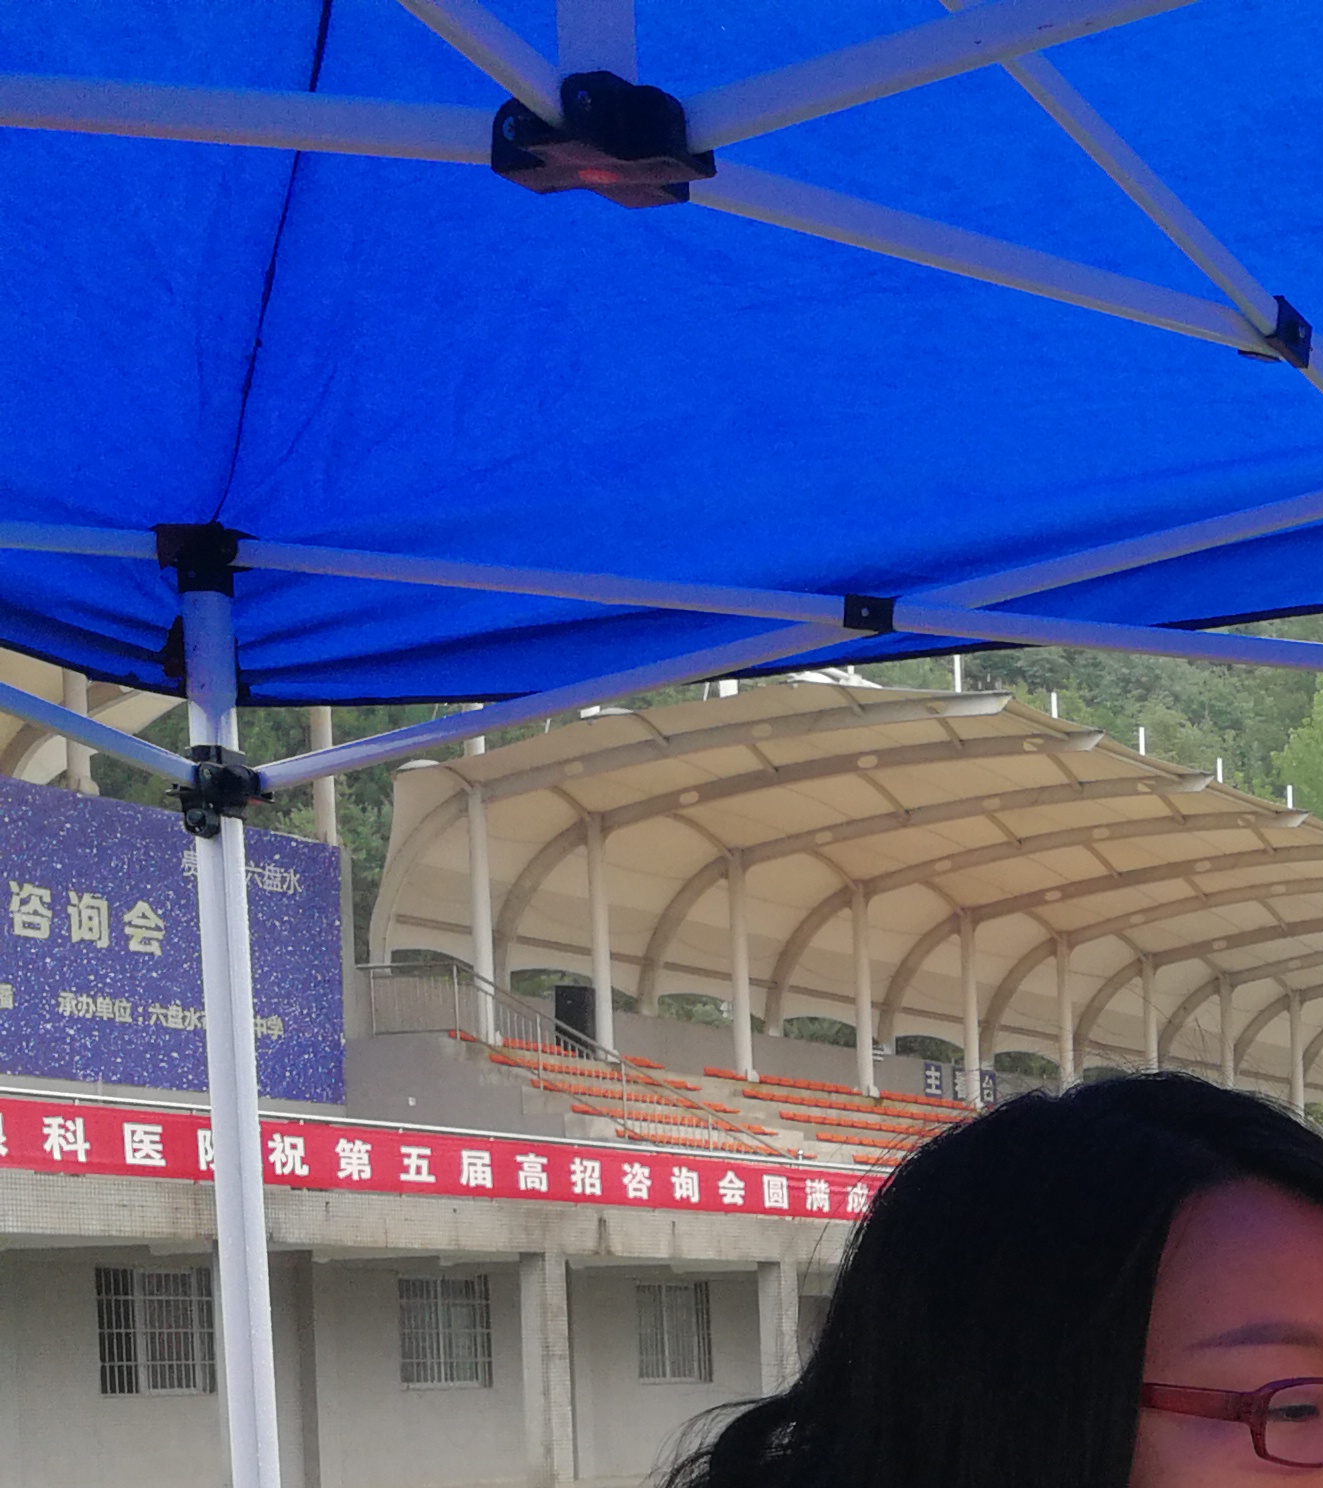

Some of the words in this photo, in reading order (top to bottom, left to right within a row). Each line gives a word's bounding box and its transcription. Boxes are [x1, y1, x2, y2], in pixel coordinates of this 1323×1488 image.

[9, 880, 165, 956] 咨询会
[0, 1110, 872, 1213] 科医祝第五届高招咨询会圆满成
